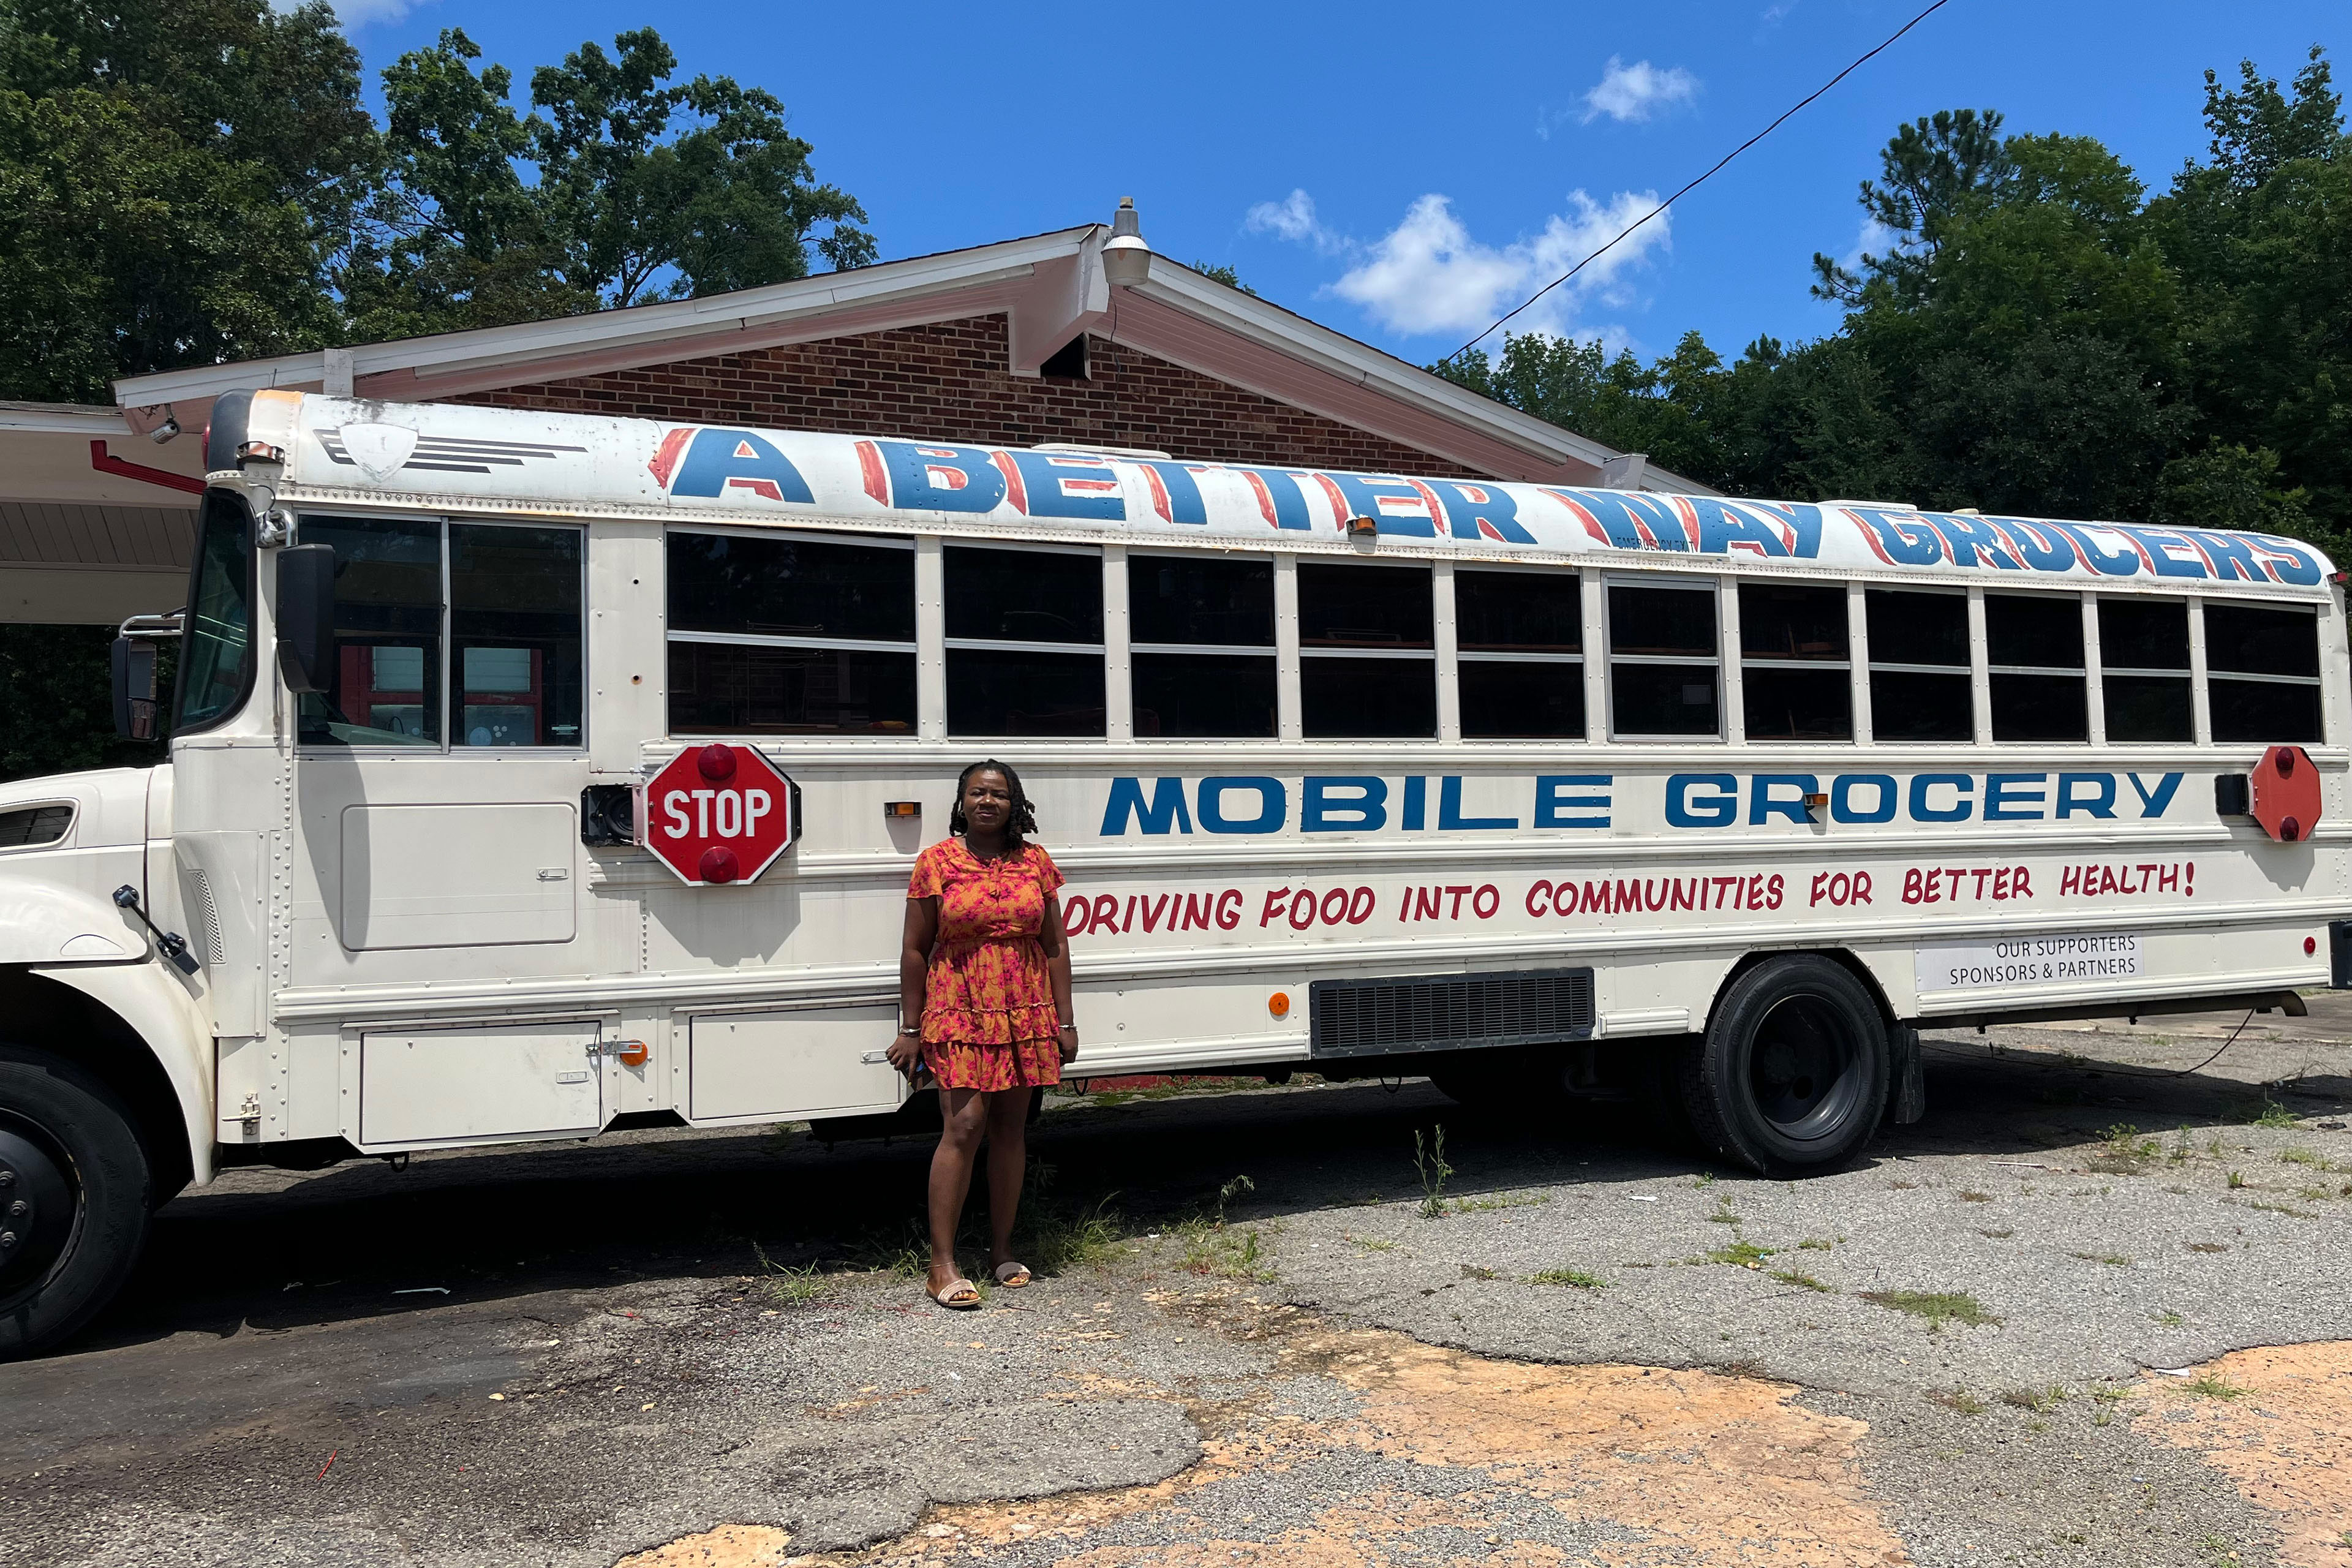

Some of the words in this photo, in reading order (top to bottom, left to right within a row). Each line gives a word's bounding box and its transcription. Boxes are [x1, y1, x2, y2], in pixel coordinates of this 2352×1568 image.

[648, 427, 816, 504] A
[854, 439, 1537, 545] BETTER
[1536, 488, 1822, 559] WAY
[1838, 508, 2322, 586] GROCERS
[663, 789, 772, 839] STOP
[1099, 775, 1613, 837] MOBILE
[1664, 772, 2185, 828] GROCERY
[1061, 889, 1243, 937] DRIVING
[1259, 886, 1376, 931] FOOD
[1399, 884, 1501, 923] INTO
[1525, 872, 1785, 918] COMMUNITIES
[1809, 870, 1873, 908] FOR
[1901, 865, 2034, 905] BETTER
[2059, 861, 2195, 897] HEALTH!
[1950, 963, 2037, 985] SPONSORS
[2043, 963, 2053, 979] &
[2059, 957, 2136, 978] PARTNERS
[1996, 941, 2031, 959] OUR
[2037, 935, 2136, 957] SUPPORTERS
